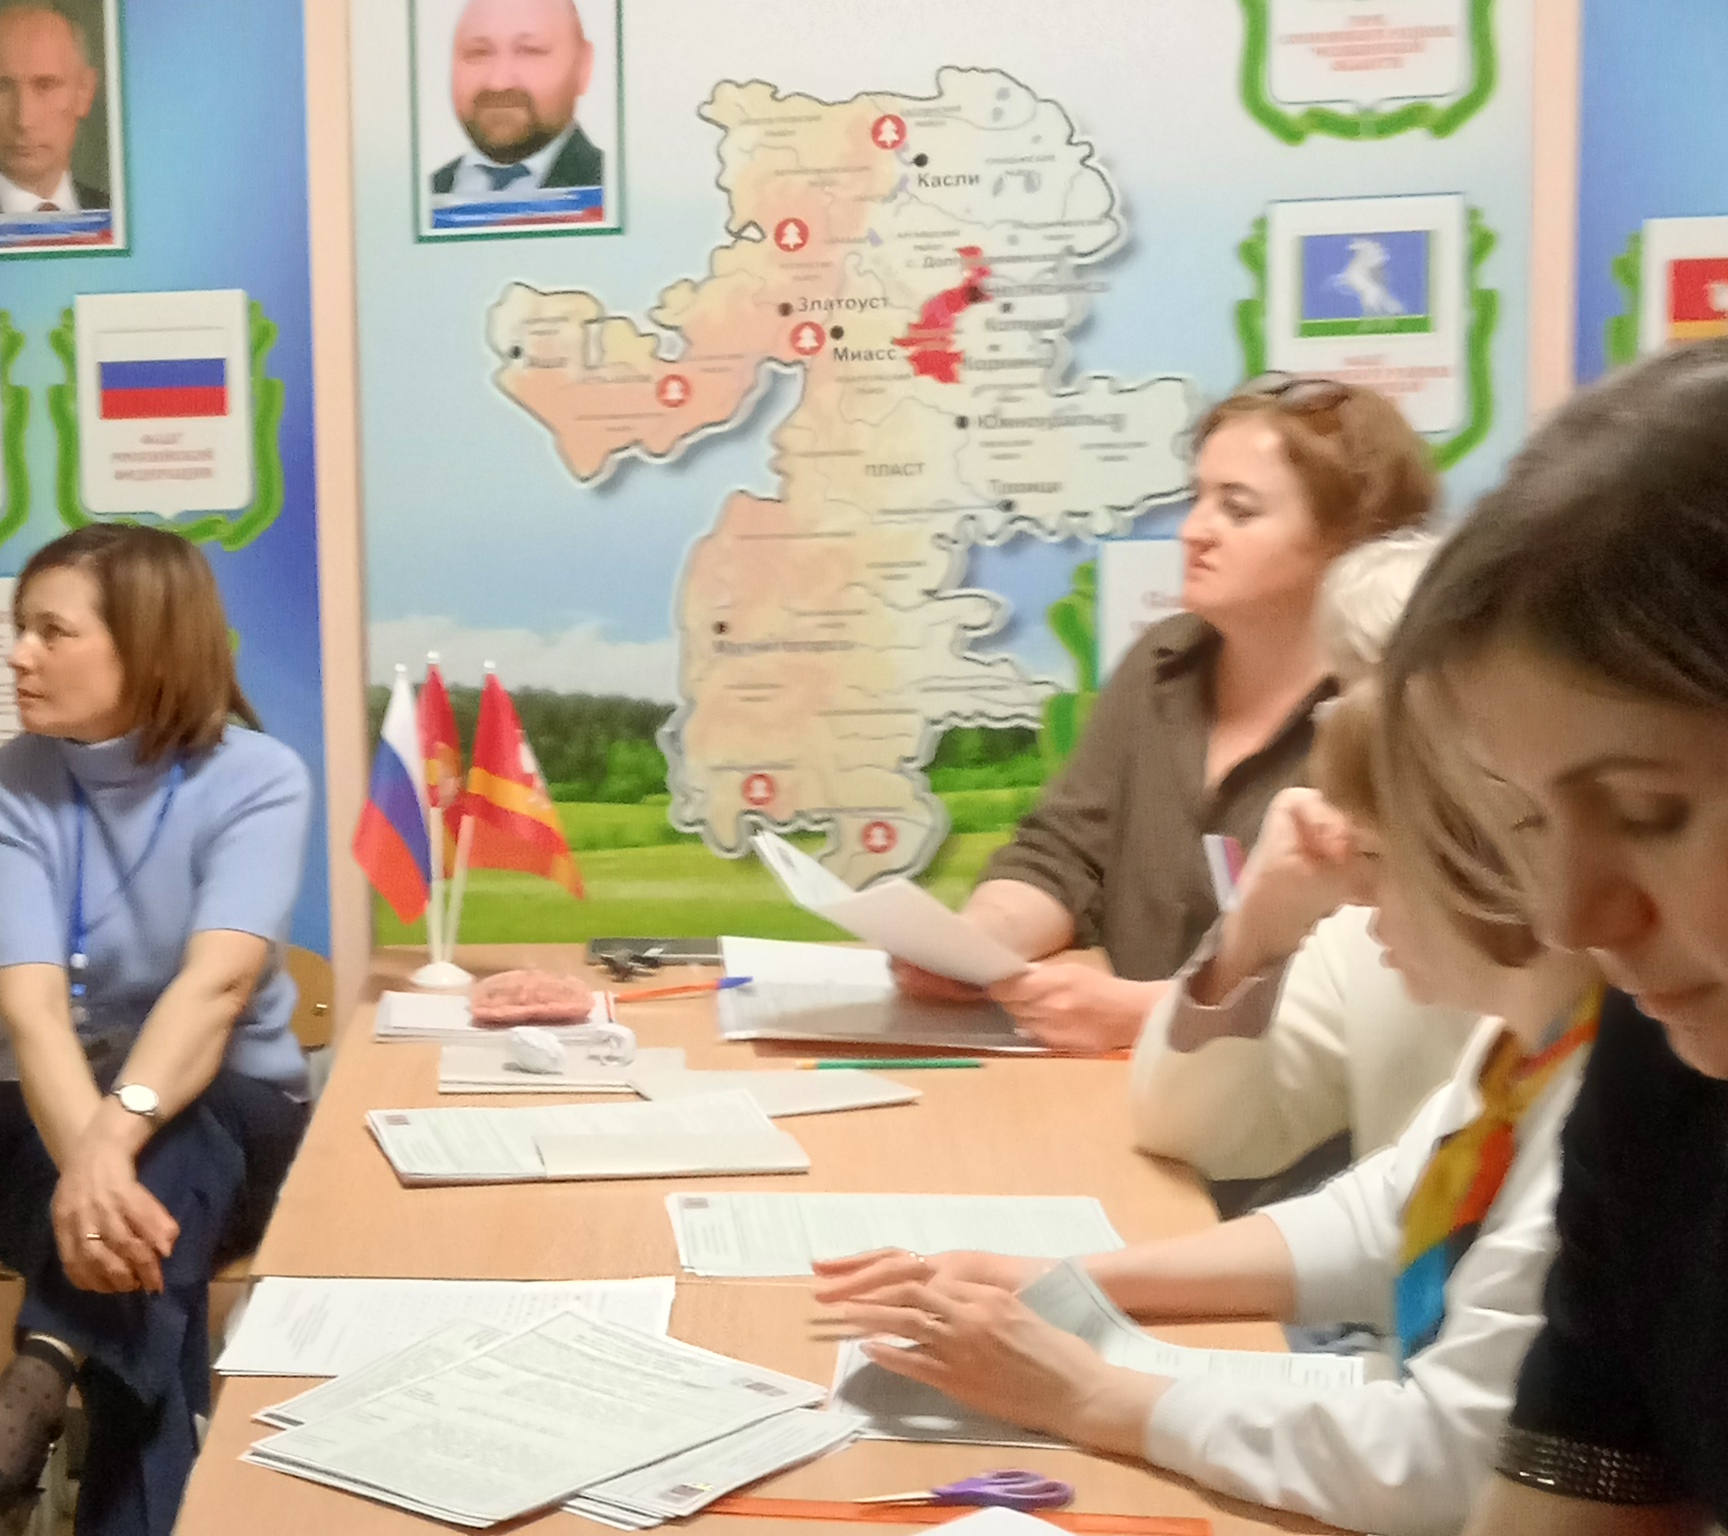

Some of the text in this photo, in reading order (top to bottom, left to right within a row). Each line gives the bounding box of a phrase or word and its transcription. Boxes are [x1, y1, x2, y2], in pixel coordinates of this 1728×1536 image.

[917, 173, 981, 189] Касли
[798, 296, 889, 313] Златоуст
[833, 346, 897, 362] Миасс
[865, 462, 925, 477] ПЛАСТ
